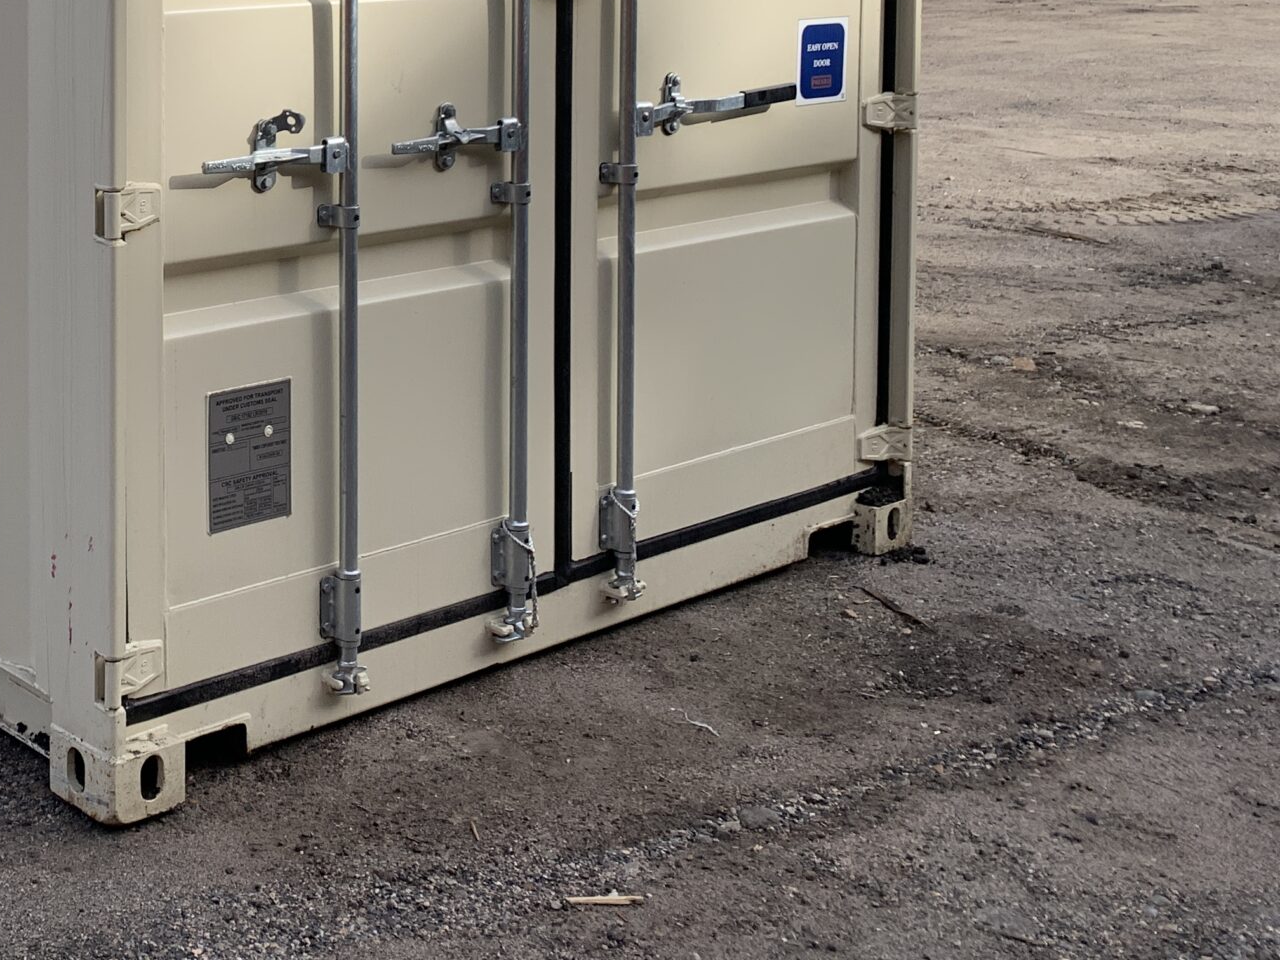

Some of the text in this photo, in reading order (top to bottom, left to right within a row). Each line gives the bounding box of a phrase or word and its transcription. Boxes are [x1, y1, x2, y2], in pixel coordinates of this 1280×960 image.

[822, 42, 839, 51] OPEN
[813, 58, 831, 67] DOOR
[216, 396, 242, 406] APPROVED
